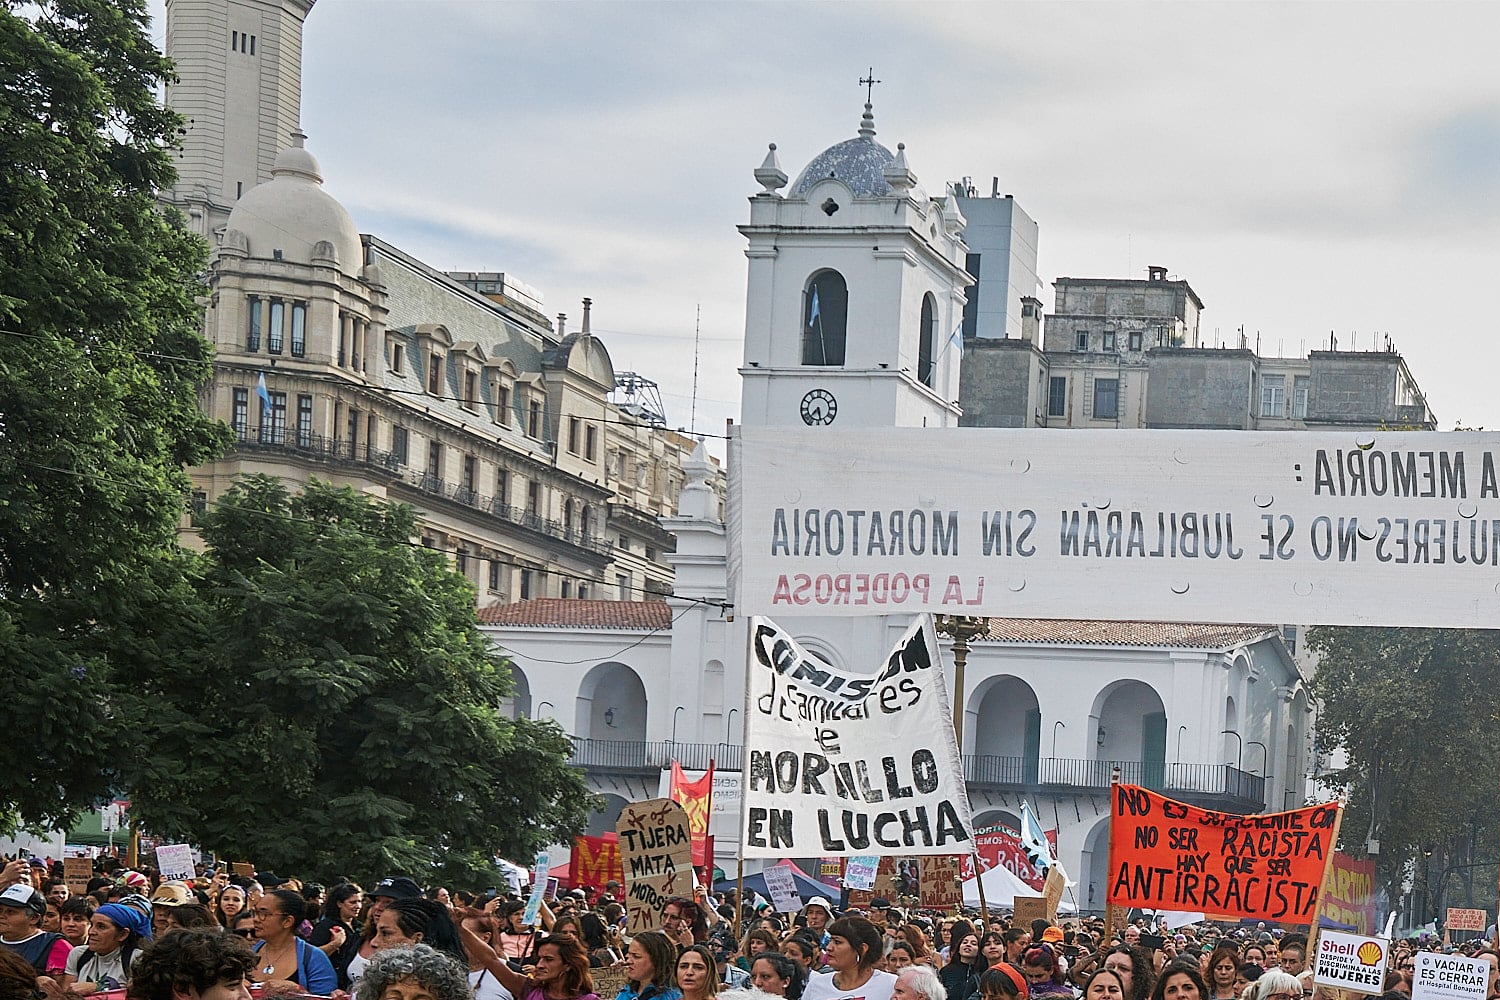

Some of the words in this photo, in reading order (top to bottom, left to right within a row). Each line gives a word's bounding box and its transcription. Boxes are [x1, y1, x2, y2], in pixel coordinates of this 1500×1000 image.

[1117, 785, 1151, 817] NO
[748, 807, 794, 849] EN
[817, 799, 970, 852] LUCHA
[620, 824, 688, 852] TIJERA
[1134, 825, 1159, 850] NO
[1169, 827, 1198, 851] SER
[630, 853, 676, 878] MATA
[1176, 851, 1211, 873] HAY
[1223, 855, 1258, 877] QUE
[1266, 856, 1291, 877] SER
[629, 906, 653, 930] 7M
[1322, 939, 1355, 955] Shell
[1319, 960, 1361, 972] DISCRIMINA
[1368, 968, 1382, 976] LAS
[1320, 953, 1349, 963] DESPIDE
[1434, 958, 1474, 974] VACIAR
[1318, 967, 1380, 986] MUJERES
[1421, 968, 1436, 979] ES
[1439, 971, 1484, 987] CERRAR
[1426, 980, 1453, 989] Hospital
[1453, 983, 1485, 994] Bonaparte
